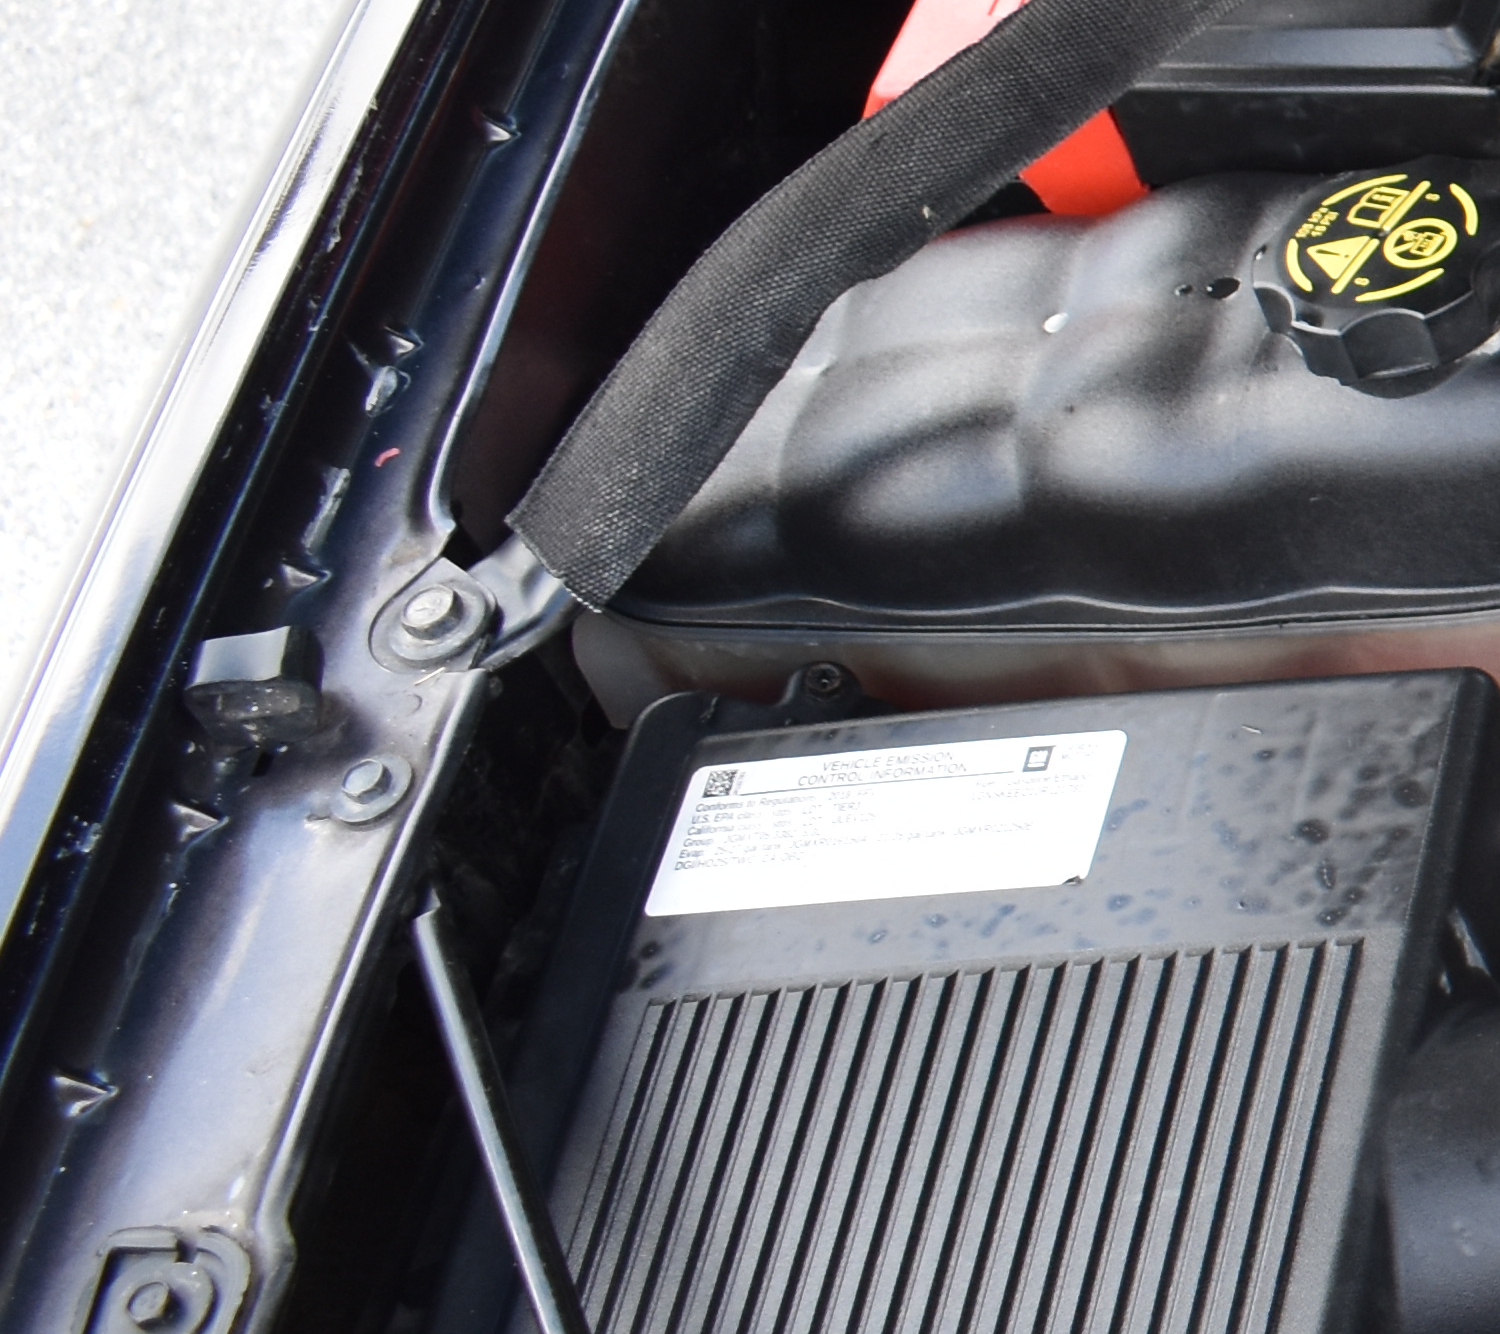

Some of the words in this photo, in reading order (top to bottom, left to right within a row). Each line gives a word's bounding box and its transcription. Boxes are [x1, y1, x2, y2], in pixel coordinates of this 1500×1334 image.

[822, 758, 881, 772] VEHICLE
[886, 752, 954, 767] EMISSION
[797, 772, 865, 786] CONTROL
[869, 763, 968, 781] INFORMATION
